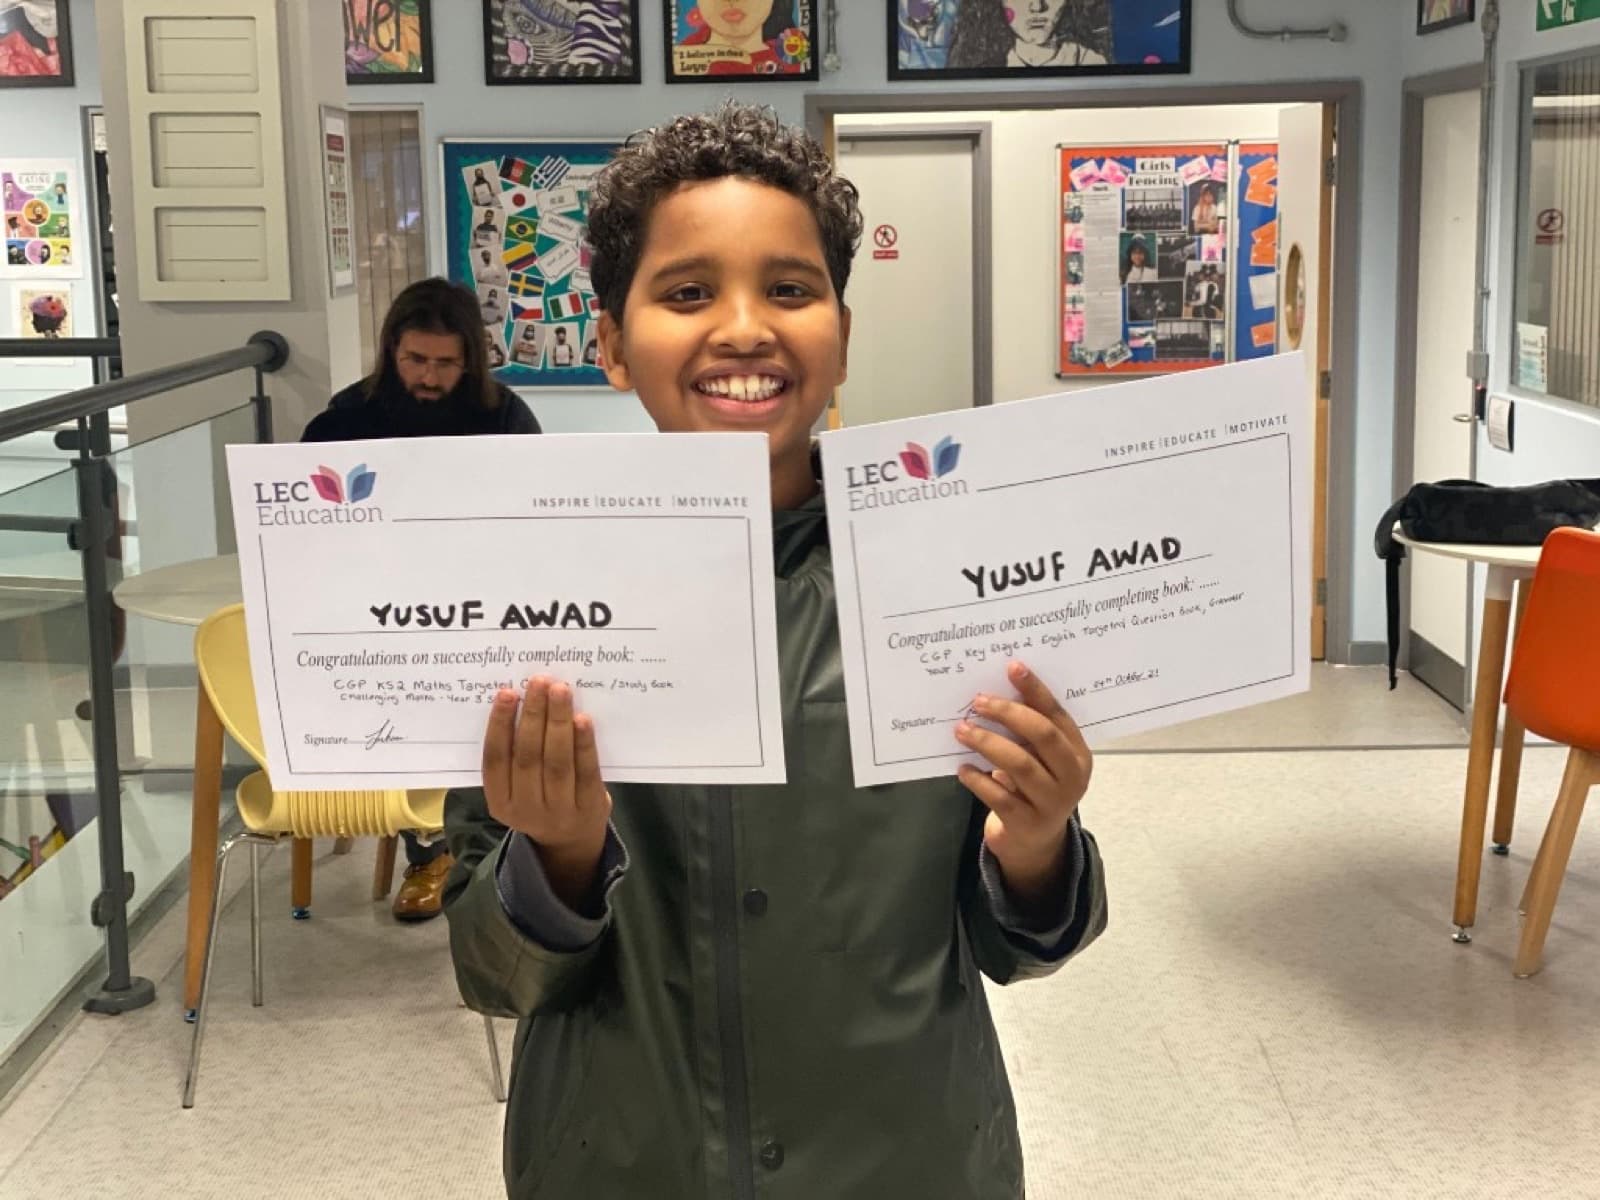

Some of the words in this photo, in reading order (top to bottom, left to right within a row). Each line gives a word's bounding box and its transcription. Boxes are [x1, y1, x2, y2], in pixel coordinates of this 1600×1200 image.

[1140, 159, 1171, 171] Girls
[1104, 439, 1155, 459] INSPIRE
[1163, 428, 1217, 449] EDUCATE
[1228, 413, 1288, 434] MOTIVATE
[845, 459, 899, 488] LEC
[253, 480, 310, 504] LEC
[532, 496, 591, 508] INSPIRE
[599, 496, 663, 508] EDUCATE
[677, 496, 749, 508] MOTIVATE
[847, 477, 970, 512] Education
[255, 502, 384, 526] Education
[961, 550, 1065, 599] YUSUF
[1087, 537, 1182, 578] AWAD
[370, 600, 485, 629] YUSUF
[499, 599, 613, 630] AWAD
[888, 620, 996, 650] Congratulations
[999, 618, 1017, 632] on
[1018, 600, 1092, 630] successfully
[1094, 587, 1160, 612] completing
[1022, 636, 1034, 648] 2
[296, 649, 408, 671] Congratulations
[412, 652, 429, 665] on
[432, 645, 515, 667] successfully
[518, 645, 593, 666] completing
[597, 645, 634, 663] book:
[333, 679, 367, 691] CGP
[413, 679, 452, 691] Maths
[1065, 687, 1087, 701] Date
[890, 716, 936, 732] Signature
[303, 733, 349, 746] Signature
